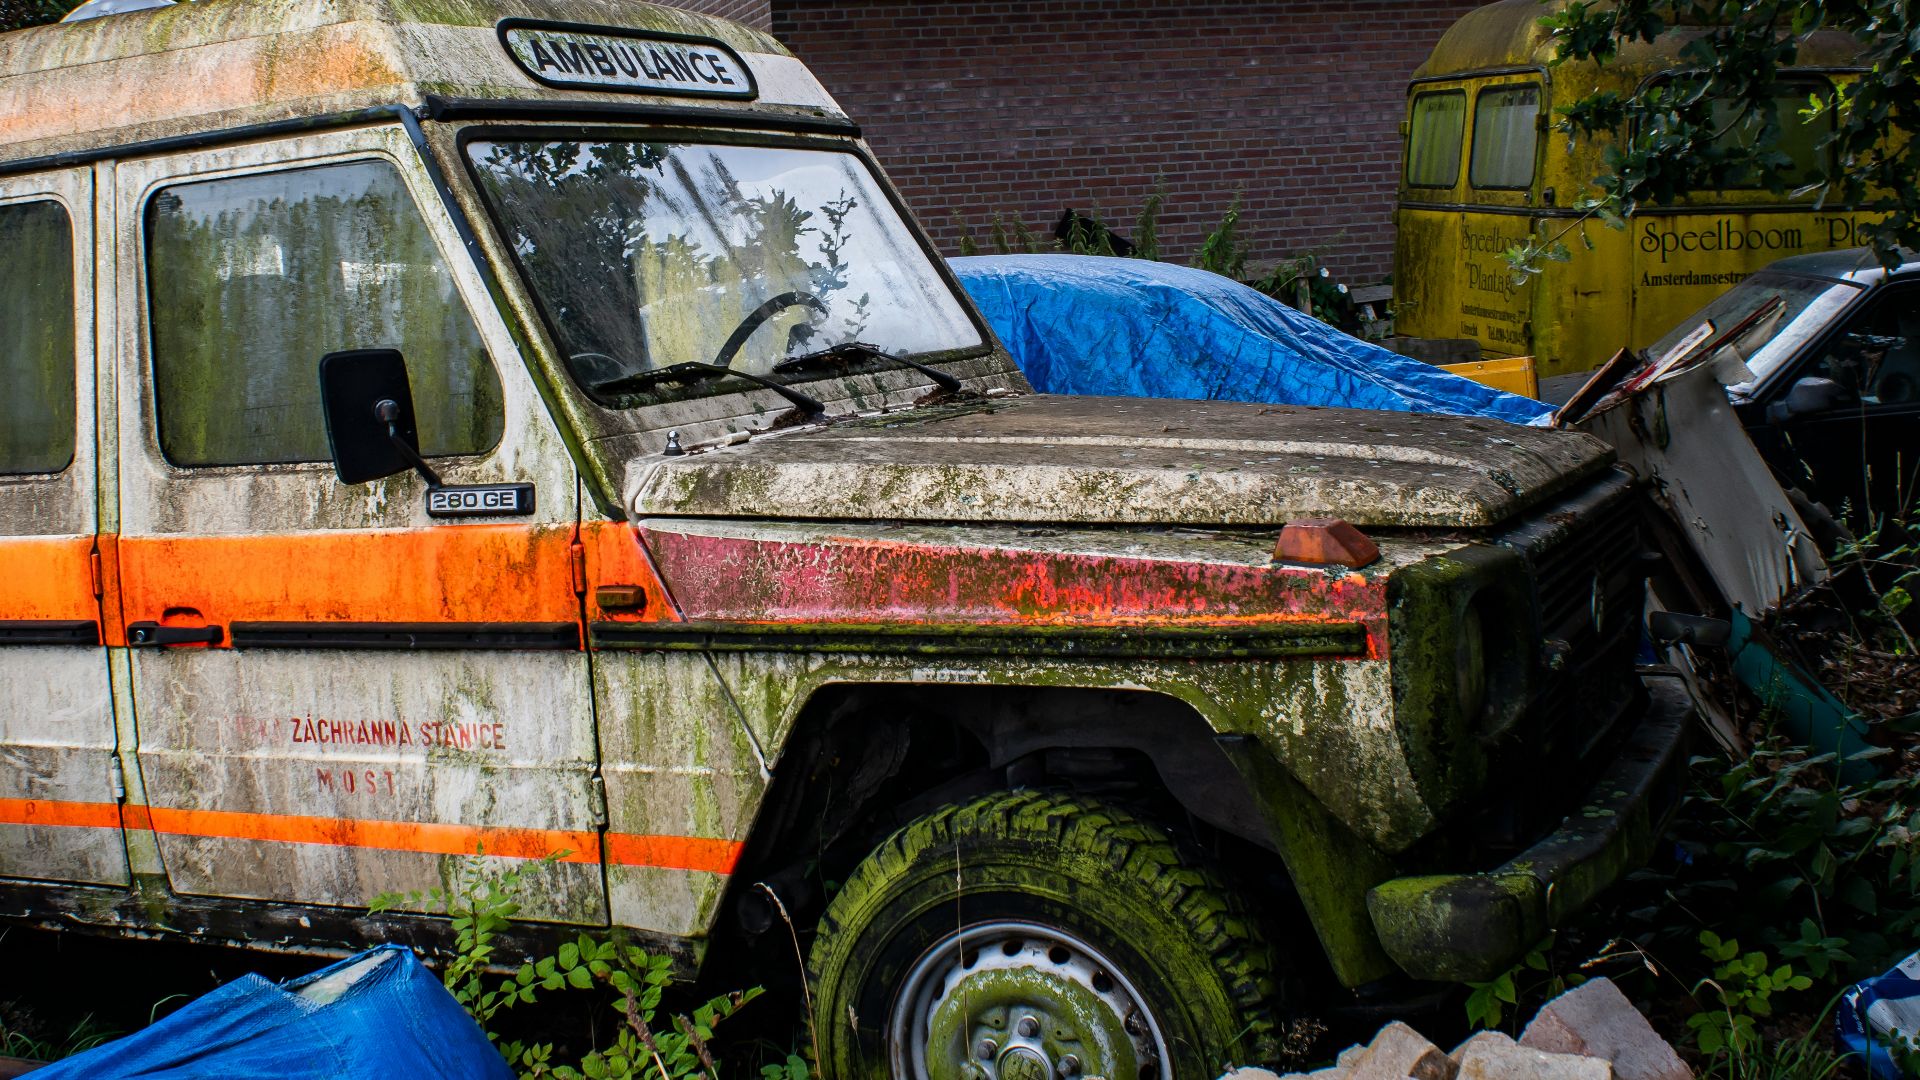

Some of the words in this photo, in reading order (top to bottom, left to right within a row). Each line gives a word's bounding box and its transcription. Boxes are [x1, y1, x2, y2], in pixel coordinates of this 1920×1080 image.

[530, 39, 735, 85] AMBULANCE
[1640, 219, 1802, 263] Speelboom
[433, 494, 477, 508] 280
[483, 491, 514, 507] GE
[420, 720, 506, 751] STANICE
[317, 768, 395, 796] MOST
